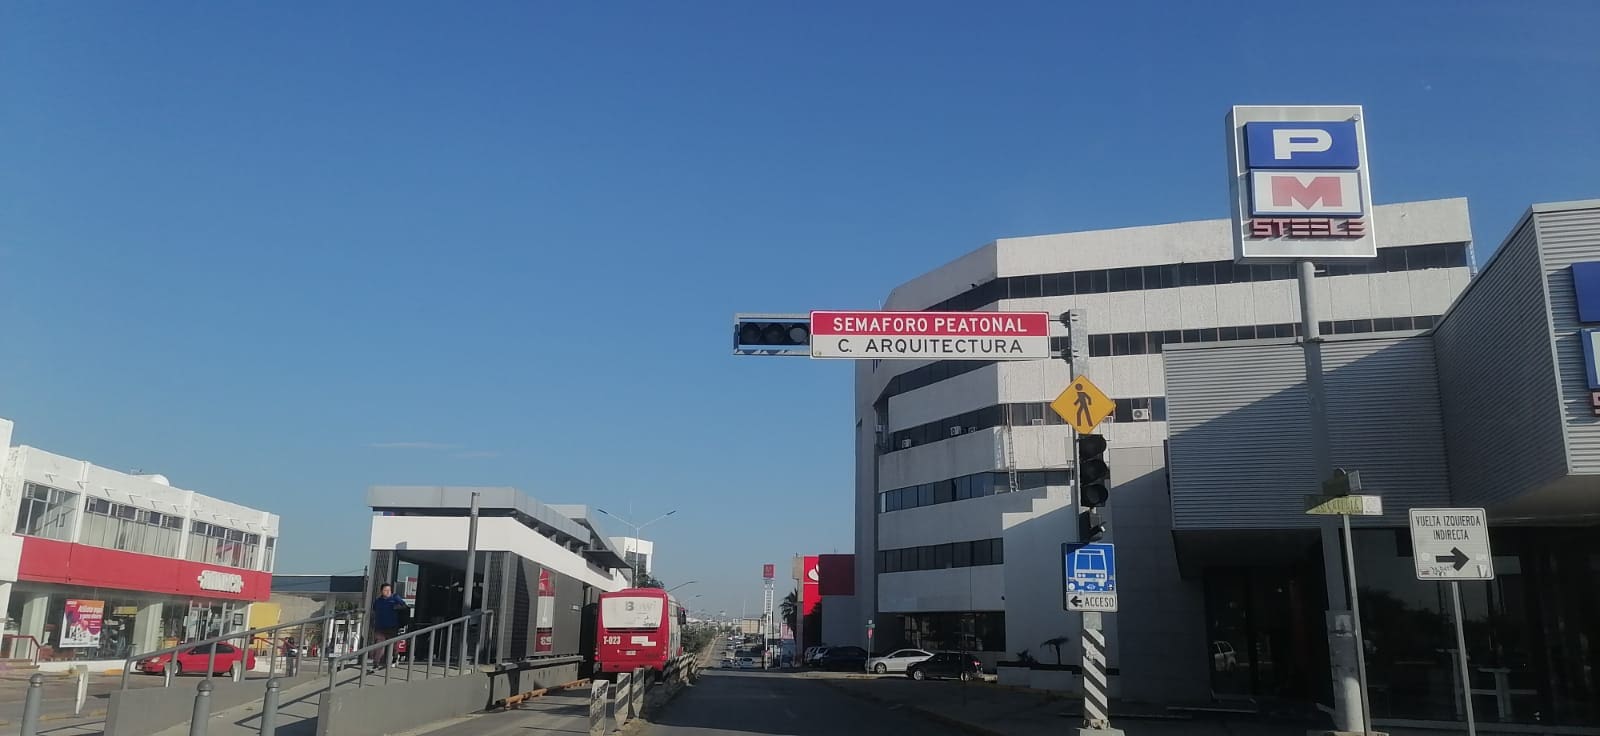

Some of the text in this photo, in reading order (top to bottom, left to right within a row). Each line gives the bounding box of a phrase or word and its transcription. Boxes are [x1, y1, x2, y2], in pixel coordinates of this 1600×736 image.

[1272, 129, 1333, 160] P
[1271, 176, 1342, 210] M
[1252, 218, 1365, 238] STEELE
[833, 317, 1028, 333] SEMAFORO PEATONAL
[838, 338, 1023, 353] C. ARQUITECTURA
[1415, 515, 1481, 527] VUELTA IZQUIERDA
[1433, 529, 1470, 541] INDIRECTA
[1085, 596, 1114, 608] ACCESO
[603, 636, 621, 645] T-023
